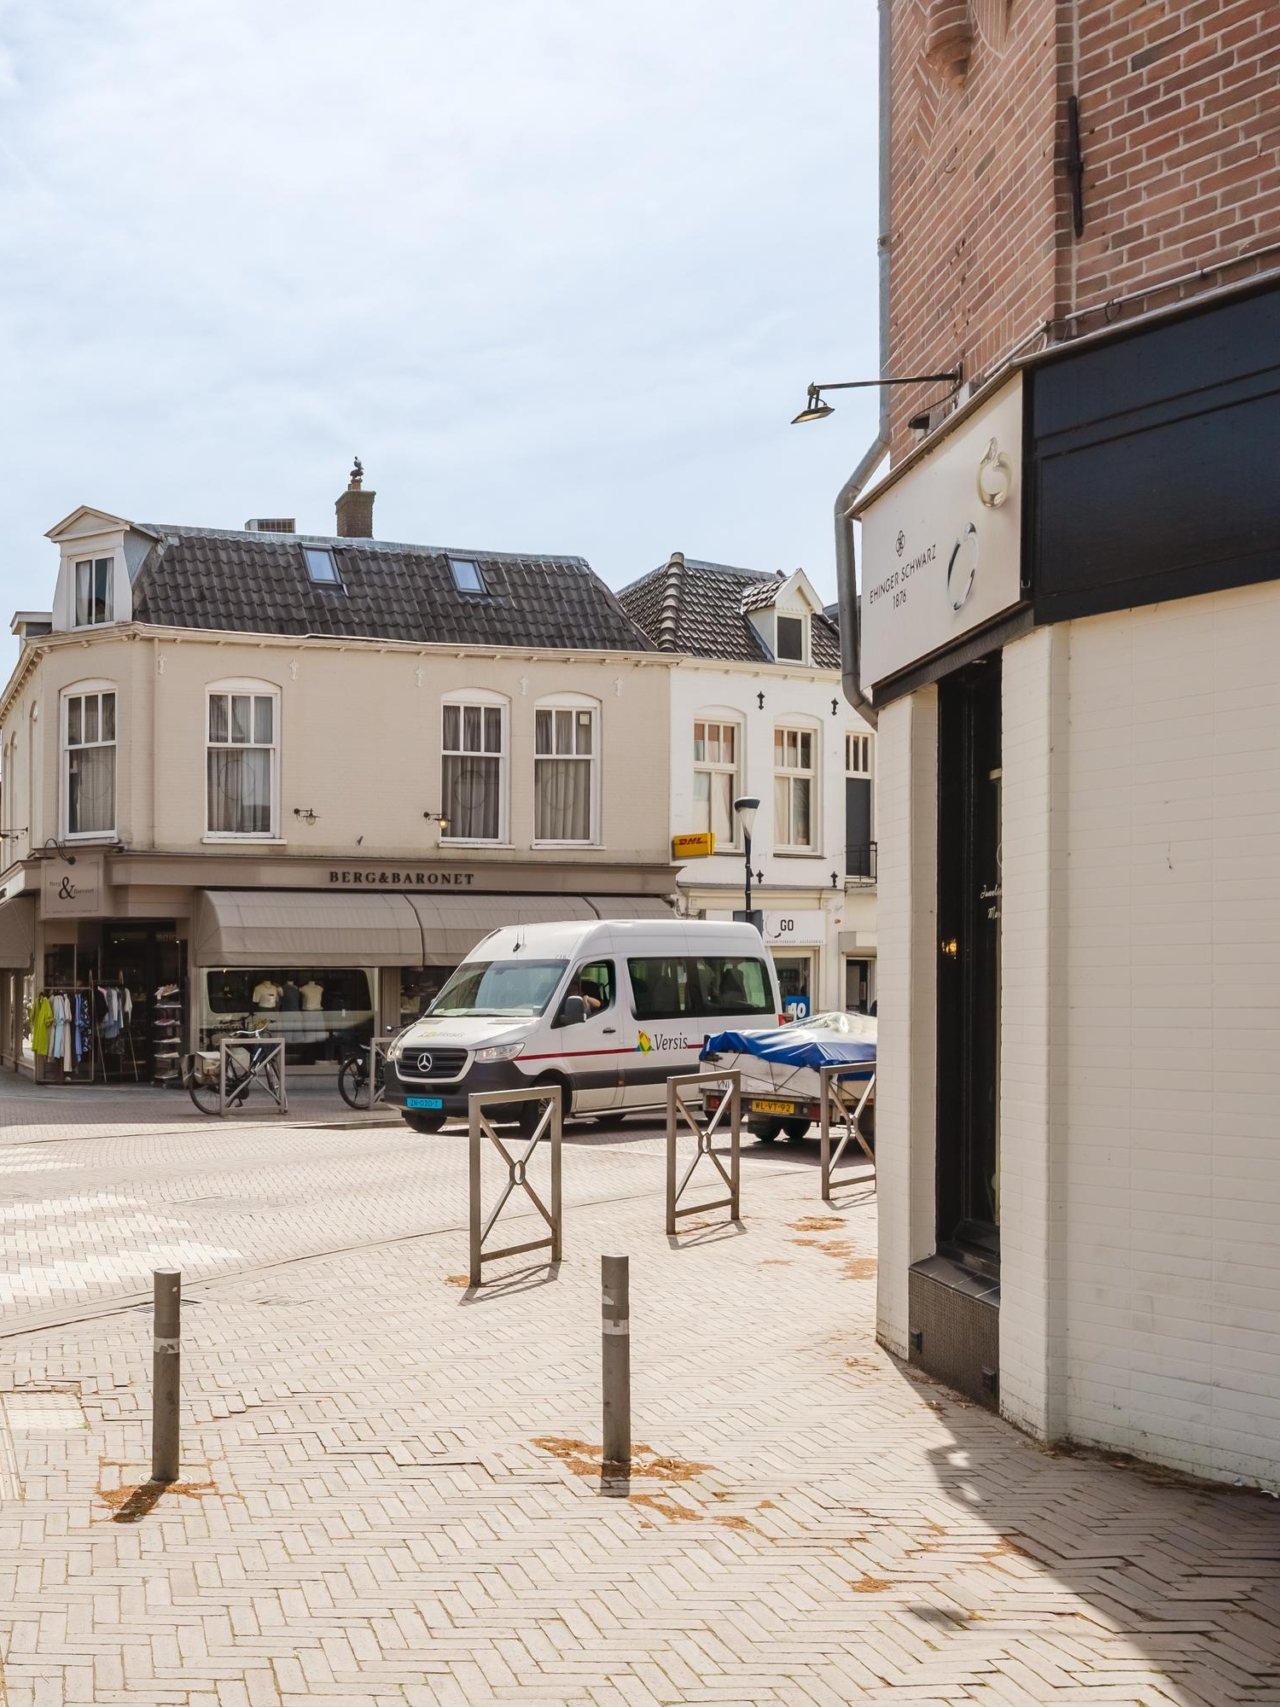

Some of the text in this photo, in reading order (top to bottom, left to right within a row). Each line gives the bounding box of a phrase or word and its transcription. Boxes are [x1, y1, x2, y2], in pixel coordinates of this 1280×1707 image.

[870, 544, 936, 605] EHINGER SCHWARZ
[893, 589, 907, 610] 1876
[678, 837, 703, 846] DHL
[329, 871, 475, 885] BERG&BARONET
[780, 919, 794, 932] GO
[653, 1032, 688, 1051] Versis
[410, 1098, 439, 1107] ZN-020-T
[755, 1103, 791, 1113] WL-VT-92
